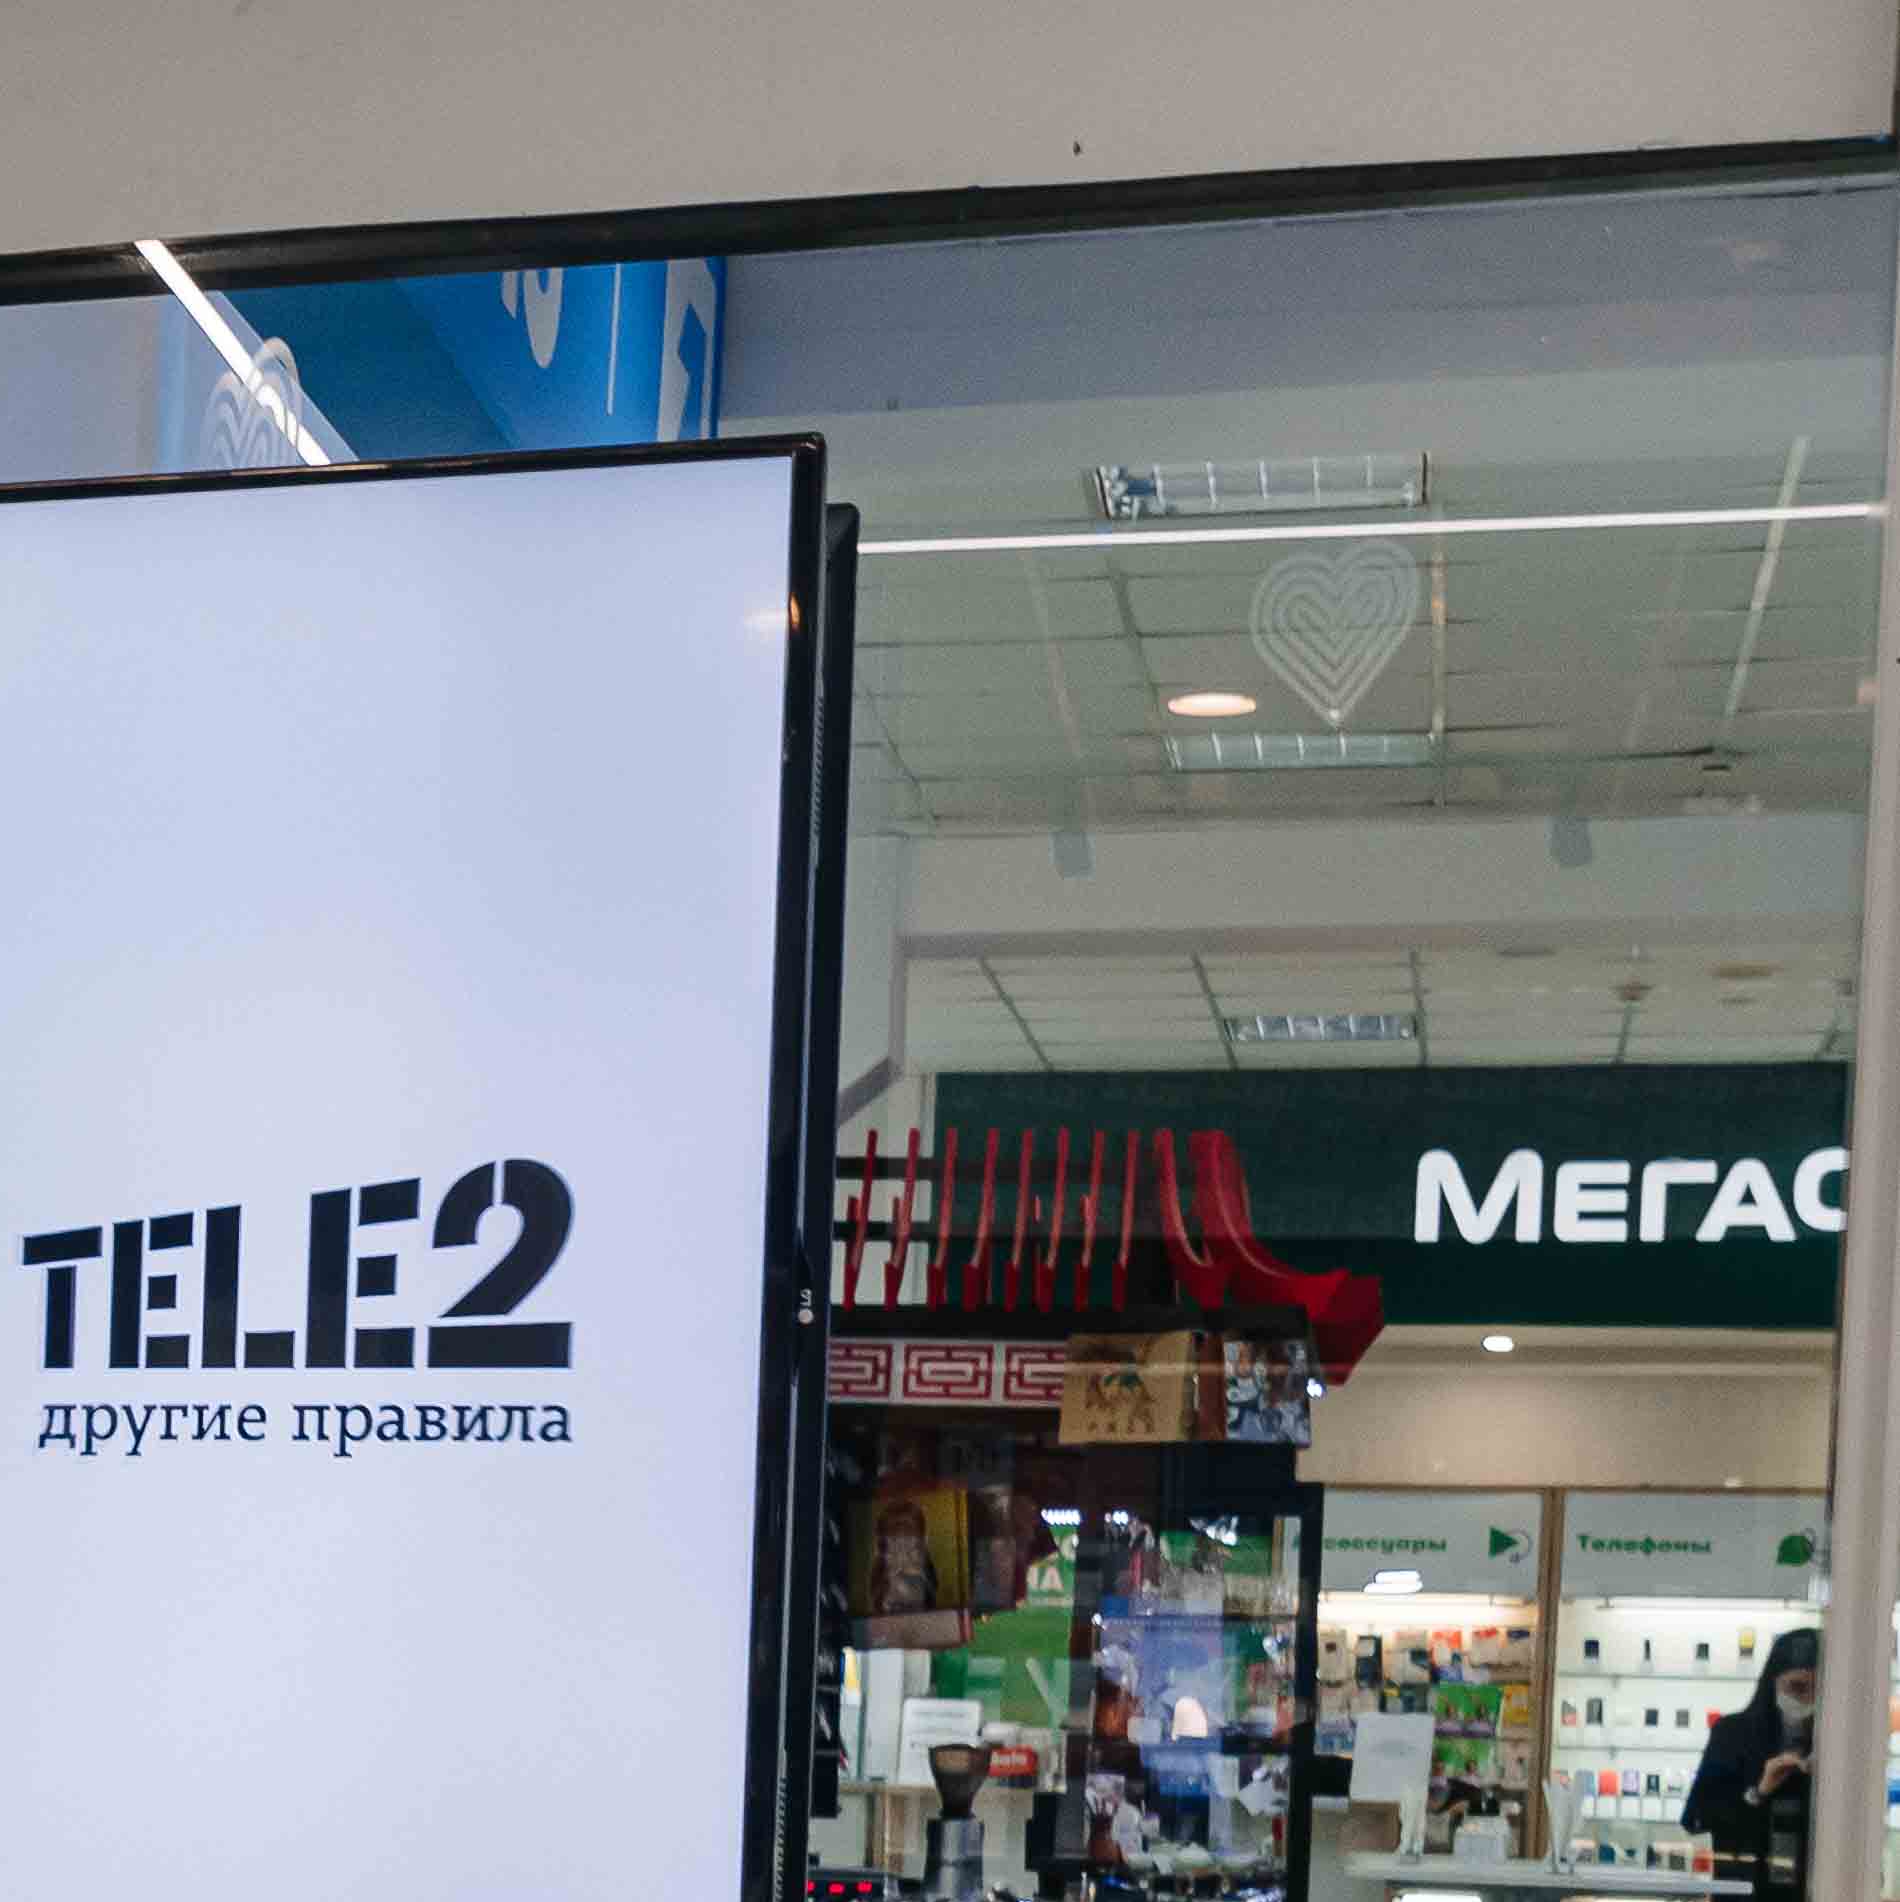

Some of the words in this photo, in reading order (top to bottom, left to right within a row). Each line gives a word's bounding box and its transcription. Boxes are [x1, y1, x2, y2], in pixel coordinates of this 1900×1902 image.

[21, 1157, 575, 1369] TELE2
[37, 1402, 268, 1458] другие
[291, 1402, 573, 1458] правила
